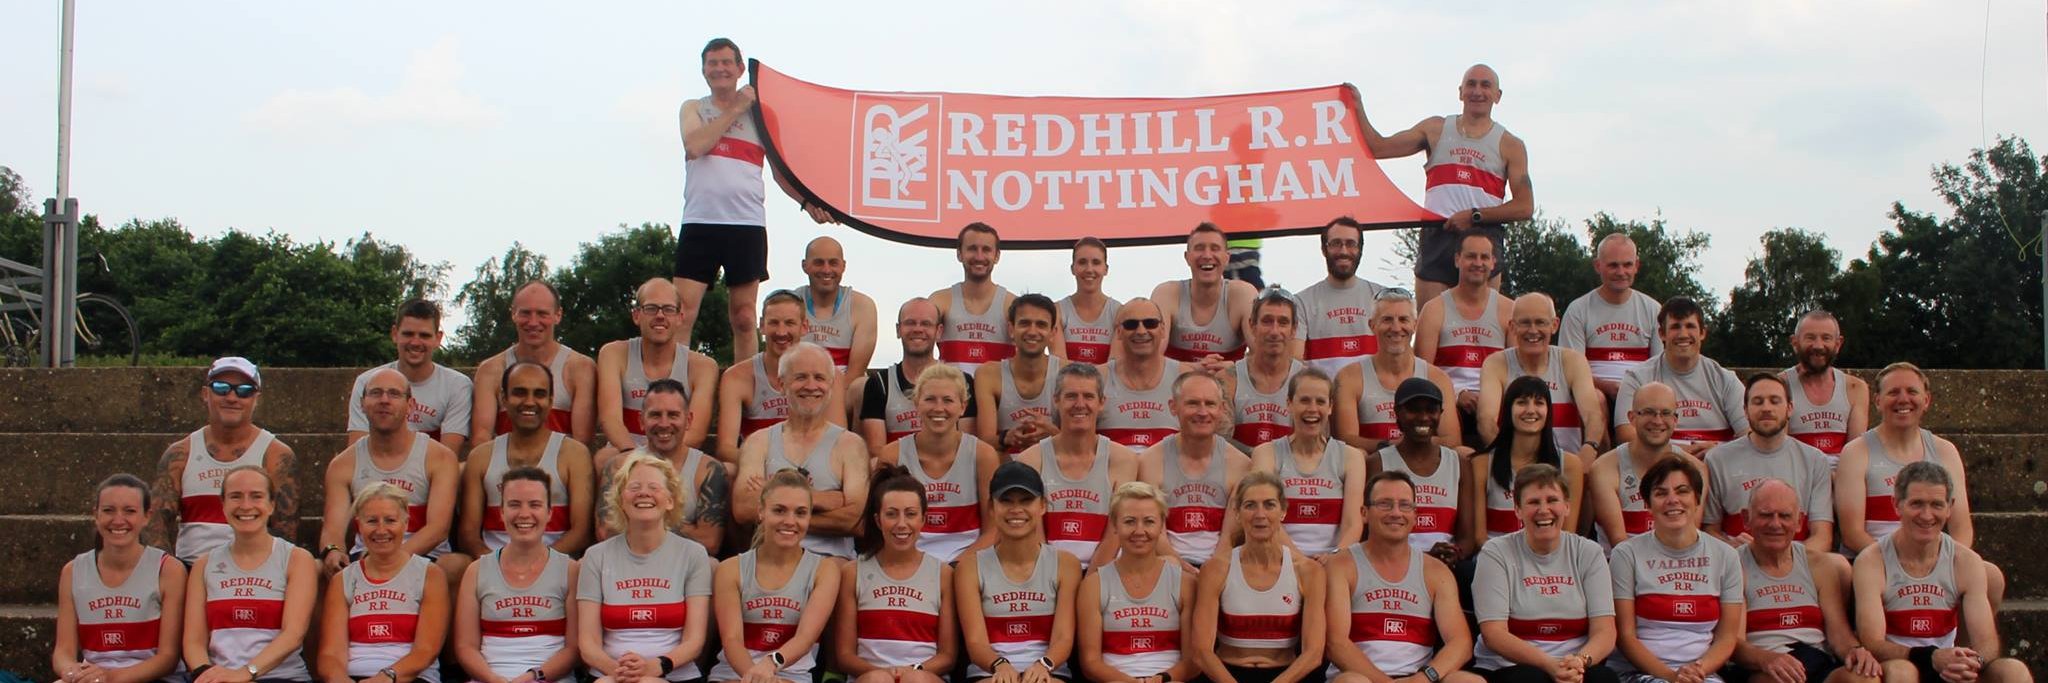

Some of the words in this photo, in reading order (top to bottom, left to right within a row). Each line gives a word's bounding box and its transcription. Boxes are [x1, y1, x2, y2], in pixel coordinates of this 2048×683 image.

[947, 109, 1229, 157] REDHILL
[1450, 148, 1485, 162] REDHILL
[946, 158, 1361, 211] NOTTINGHAM
[1327, 308, 1366, 319] REDHILL
[957, 323, 996, 334] REDHILL
[1070, 327, 1109, 336] REDHILL
[1452, 327, 1492, 338] REDHILL
[1596, 323, 1641, 336] REDHILL
[1181, 333, 1222, 344] REDHILL
[1118, 401, 1165, 414] REDHILL
[1245, 403, 1288, 417] REDHILL
[1801, 412, 1843, 424] REDHILL
[1284, 477, 1334, 489] REDHILL
[1050, 489, 1099, 502] REDHILL
[1174, 483, 1216, 498] REDHILL
[1416, 484, 1447, 498] DHILL
[1646, 557, 1710, 571] VALERIE
[220, 577, 273, 590] REDHILL
[616, 578, 671, 591] REDHILL
[1524, 575, 1574, 588] REDHILL
[1658, 572, 1708, 585] REDHILL
[354, 590, 407, 604] REDHILL
[873, 586, 923, 601] REDHILL
[1365, 589, 1418, 604] REDHILL
[1756, 584, 1805, 597] REDHILL
[1898, 584, 1944, 598] REDHILL
[88, 596, 141, 611] REDHILL
[495, 596, 552, 610] REDHILL
[746, 597, 800, 611] REDHILL
[993, 591, 1046, 605] REDHILL
[1113, 606, 1168, 620] REDHILL
